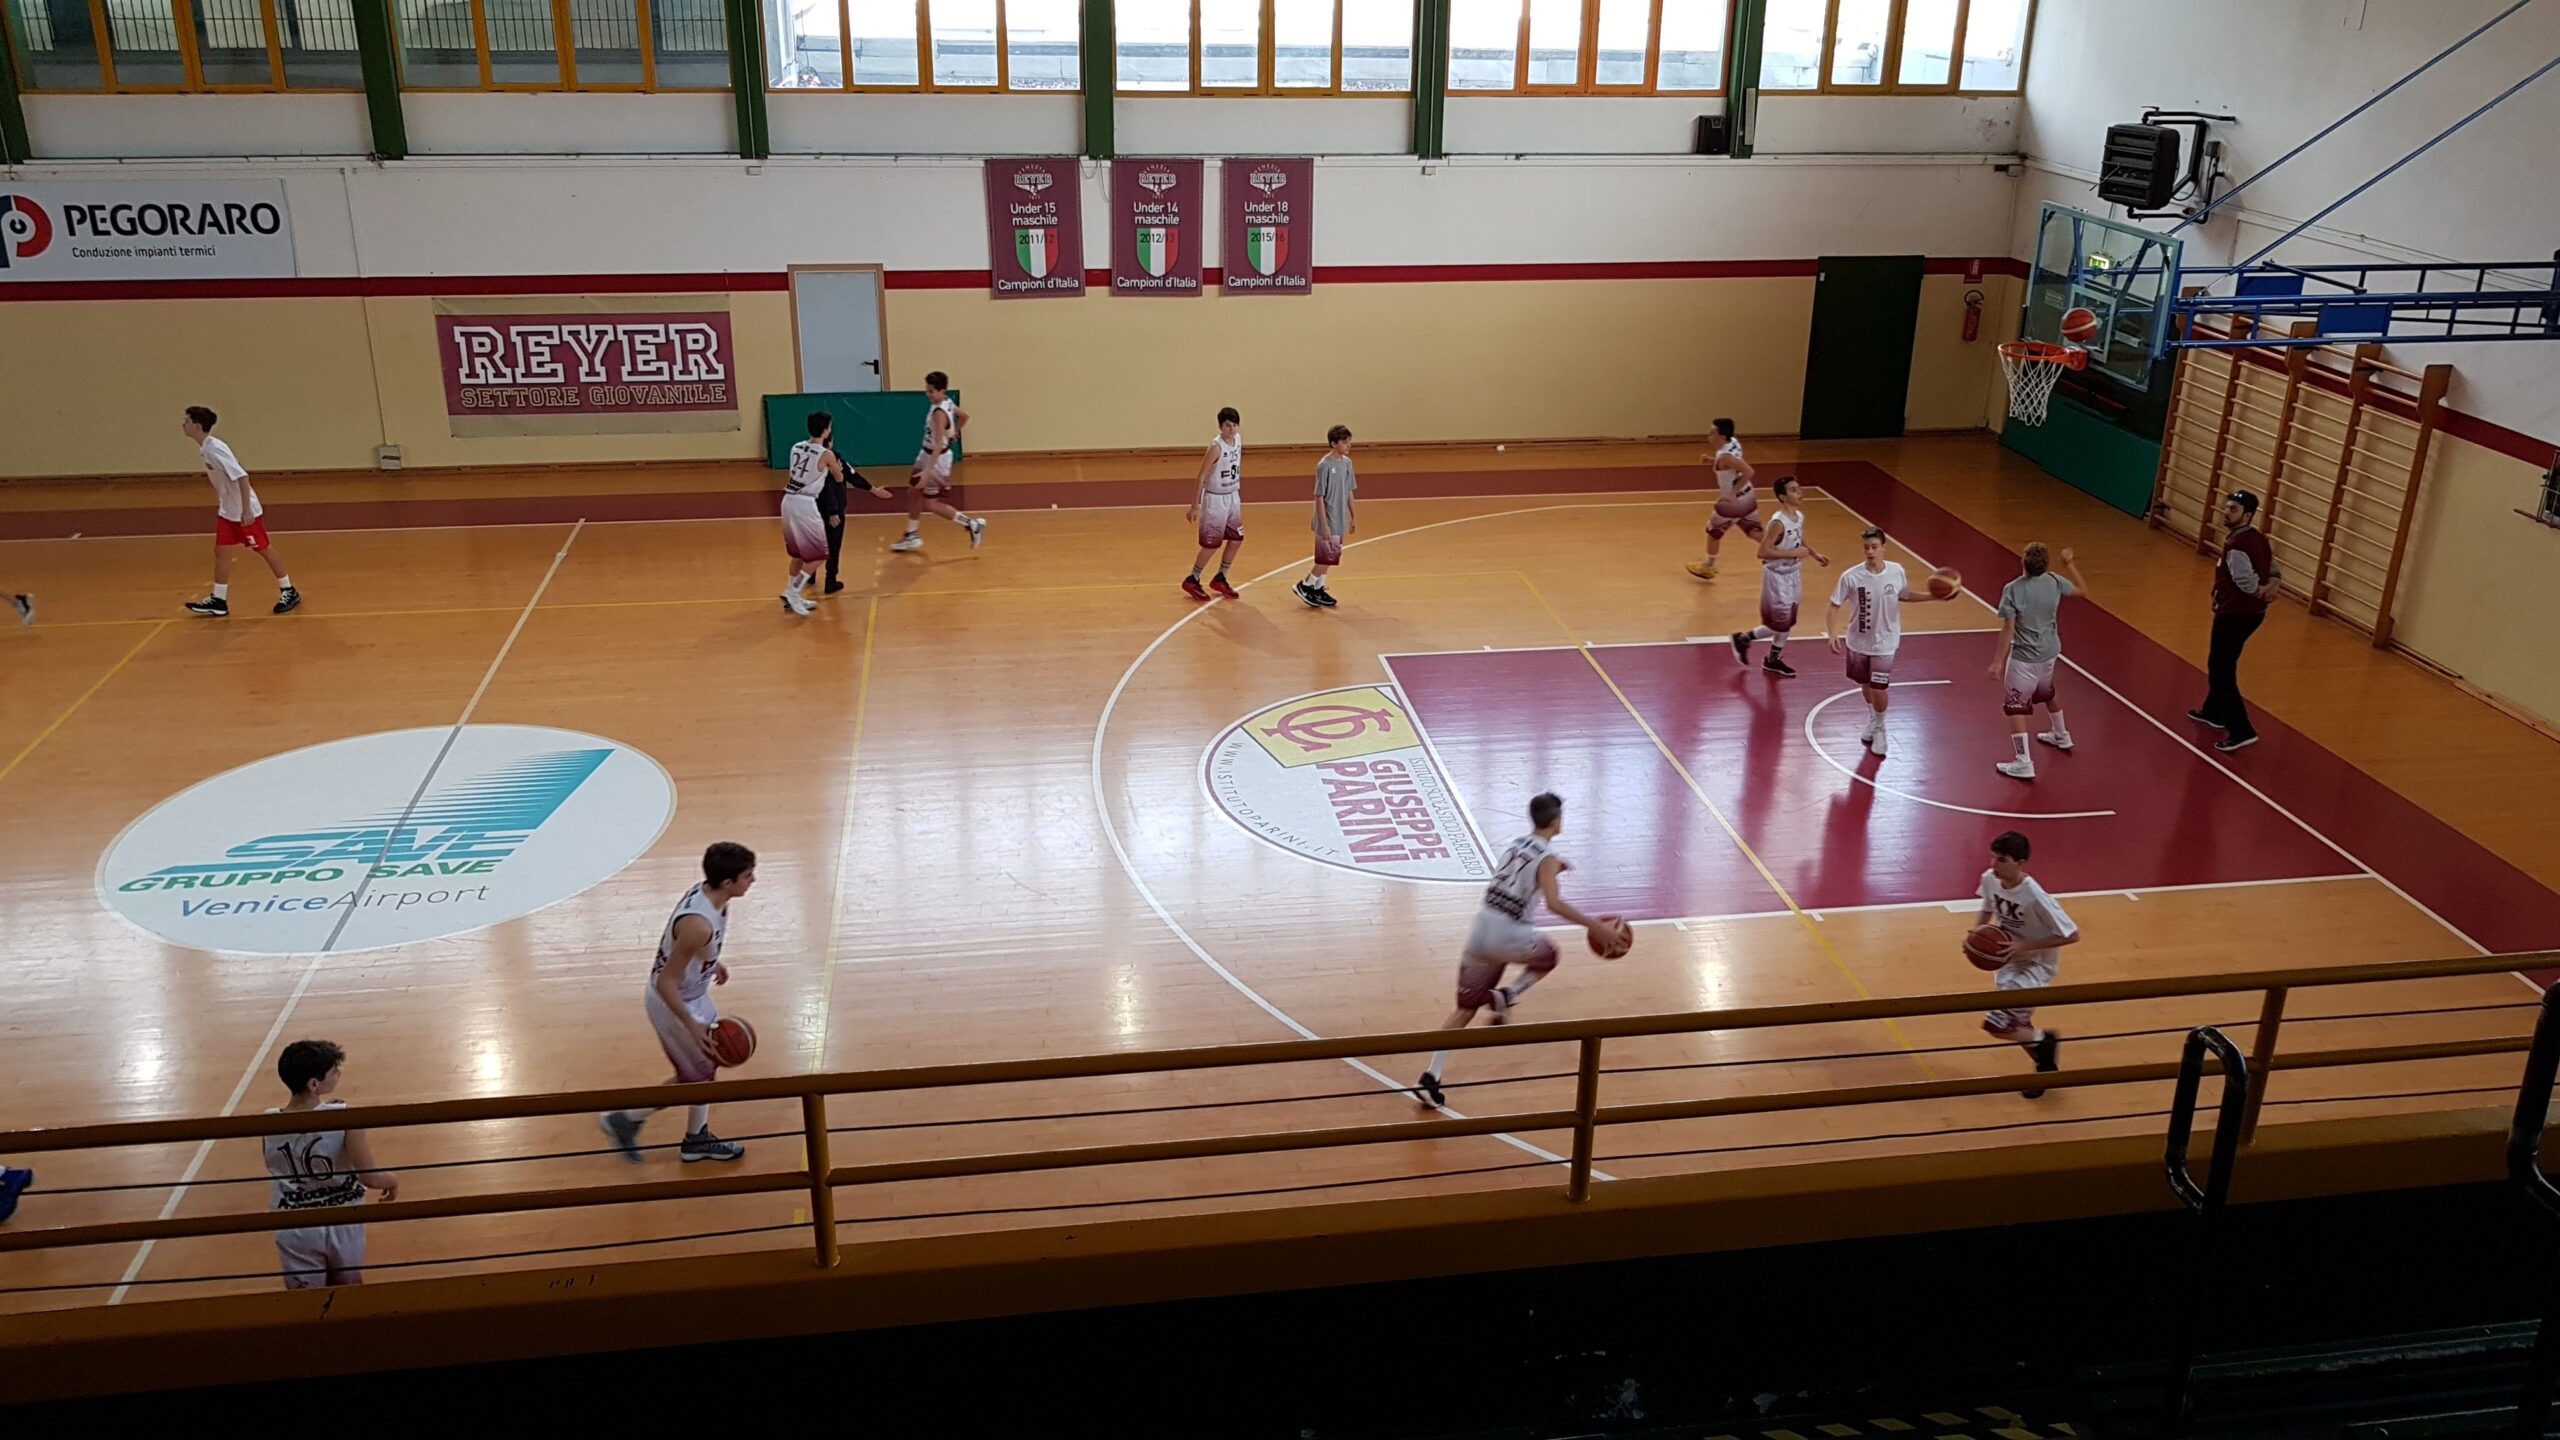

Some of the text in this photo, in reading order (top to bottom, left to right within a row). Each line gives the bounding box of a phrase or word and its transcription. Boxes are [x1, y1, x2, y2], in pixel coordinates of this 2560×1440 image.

[1010, 202, 1056, 214] Under 15
[1133, 202, 1178, 213] Under 14
[1244, 202, 1288, 213] Under 18
[63, 203, 280, 236] PEGORARO
[1012, 215, 1058, 226] maschile
[1134, 214, 1179, 224] maschile
[1245, 213, 1289, 224] maschile
[1019, 234, 1055, 245] 2011/12
[1140, 233, 1175, 243] 2012/13
[1251, 232, 1284, 242] 2015/16
[72, 245, 216, 258] Conduzione impianti termici
[998, 277, 1079, 292] Campioni d'Italia
[1117, 276, 1197, 290] Campioni d'Italia
[1228, 275, 1306, 289] Campioni d'Italia
[453, 323, 725, 384] REYER
[460, 384, 727, 408] SETTORE GIOVANILE
[791, 453, 810, 478] 24
[1216, 742, 1341, 857] WWW.ISTITUTOPARINI.IT
[1315, 761, 1412, 864] PARINI
[1368, 759, 1451, 861] GIUSEPPE
[1409, 756, 1485, 876] ISTITUTO SCOLASTICO PARITARIO
[118, 859, 503, 893] GRUPPO SAVE
[180, 883, 491, 918] VeniceAirport
[277, 1136, 334, 1184] 16
